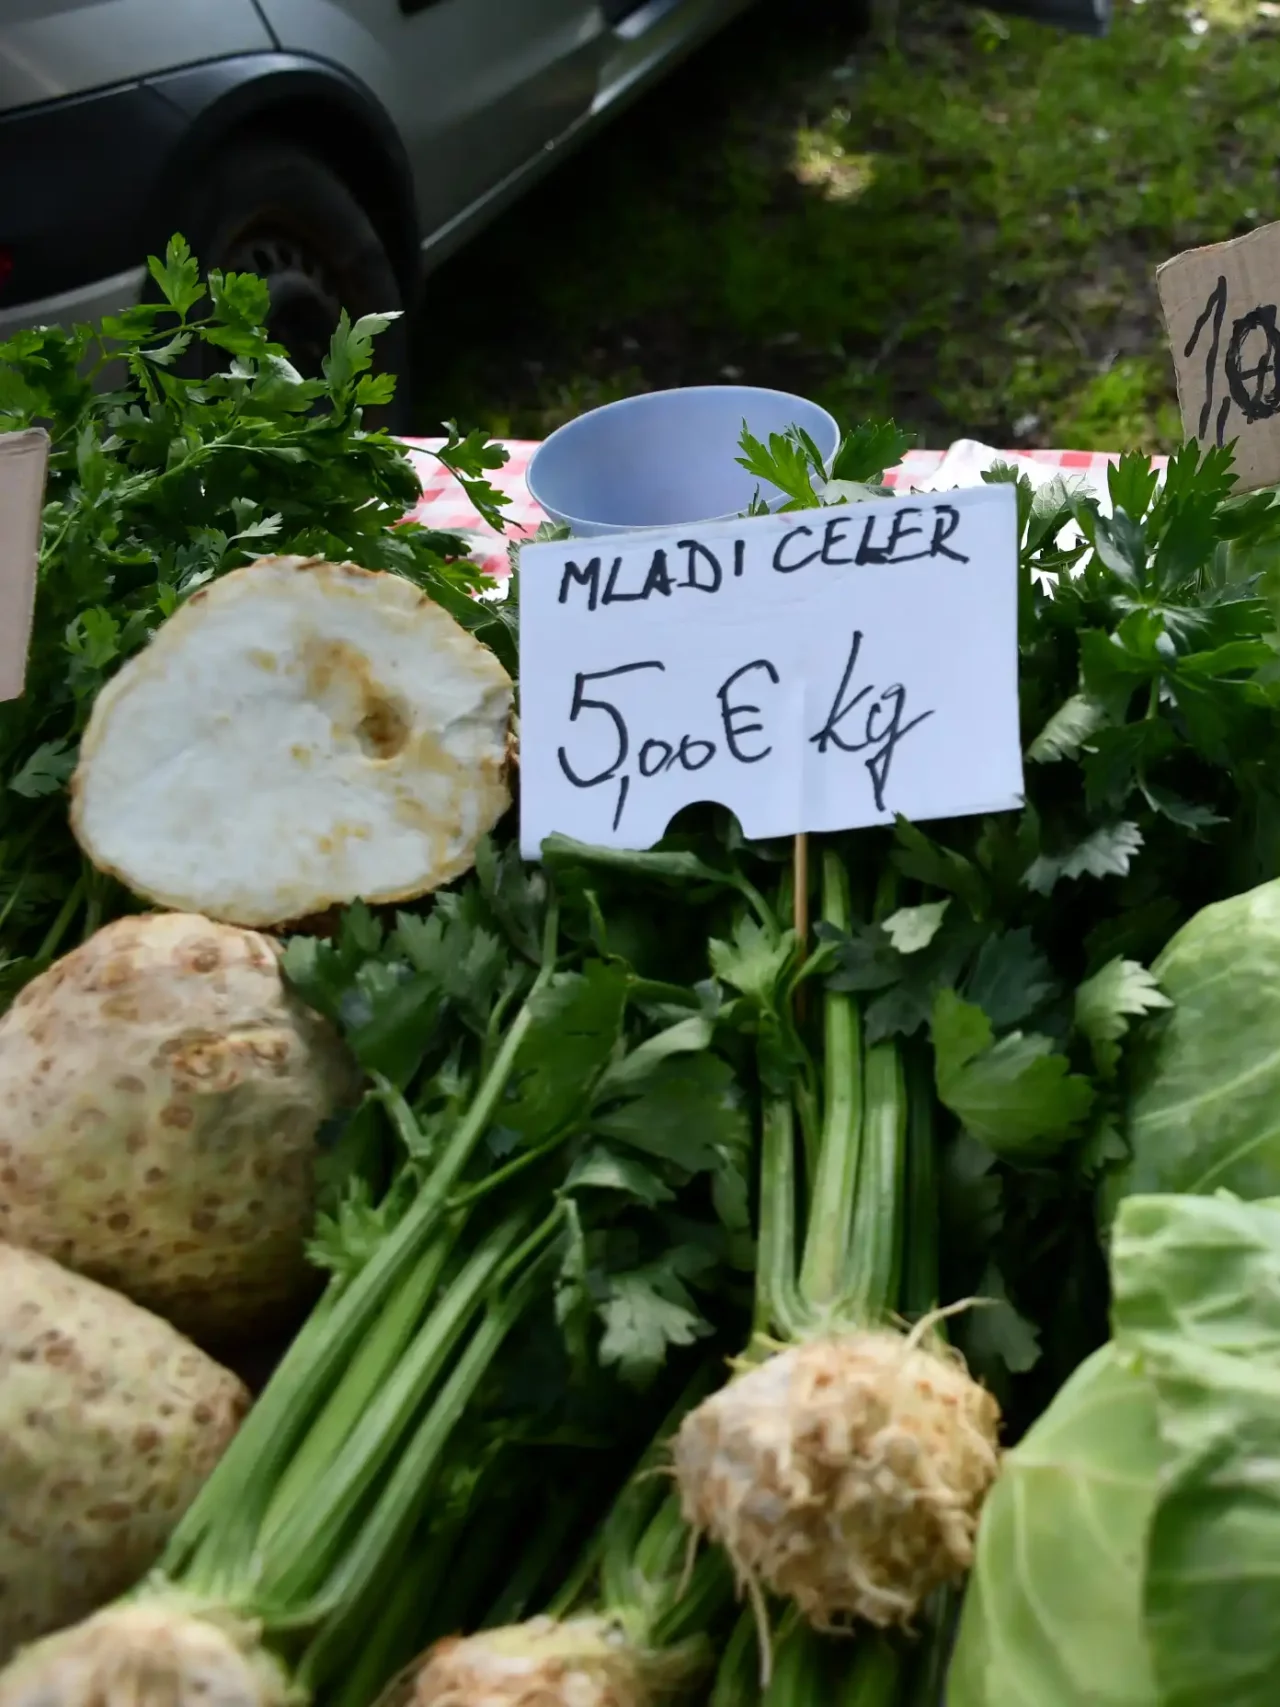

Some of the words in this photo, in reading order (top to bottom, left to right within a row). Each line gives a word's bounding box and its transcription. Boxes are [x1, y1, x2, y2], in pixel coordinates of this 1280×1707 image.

[558, 539, 745, 611] MLADI
[772, 504, 970, 573] CELER
[558, 659, 779, 832] 5,00€
[809, 630, 936, 812] kg
